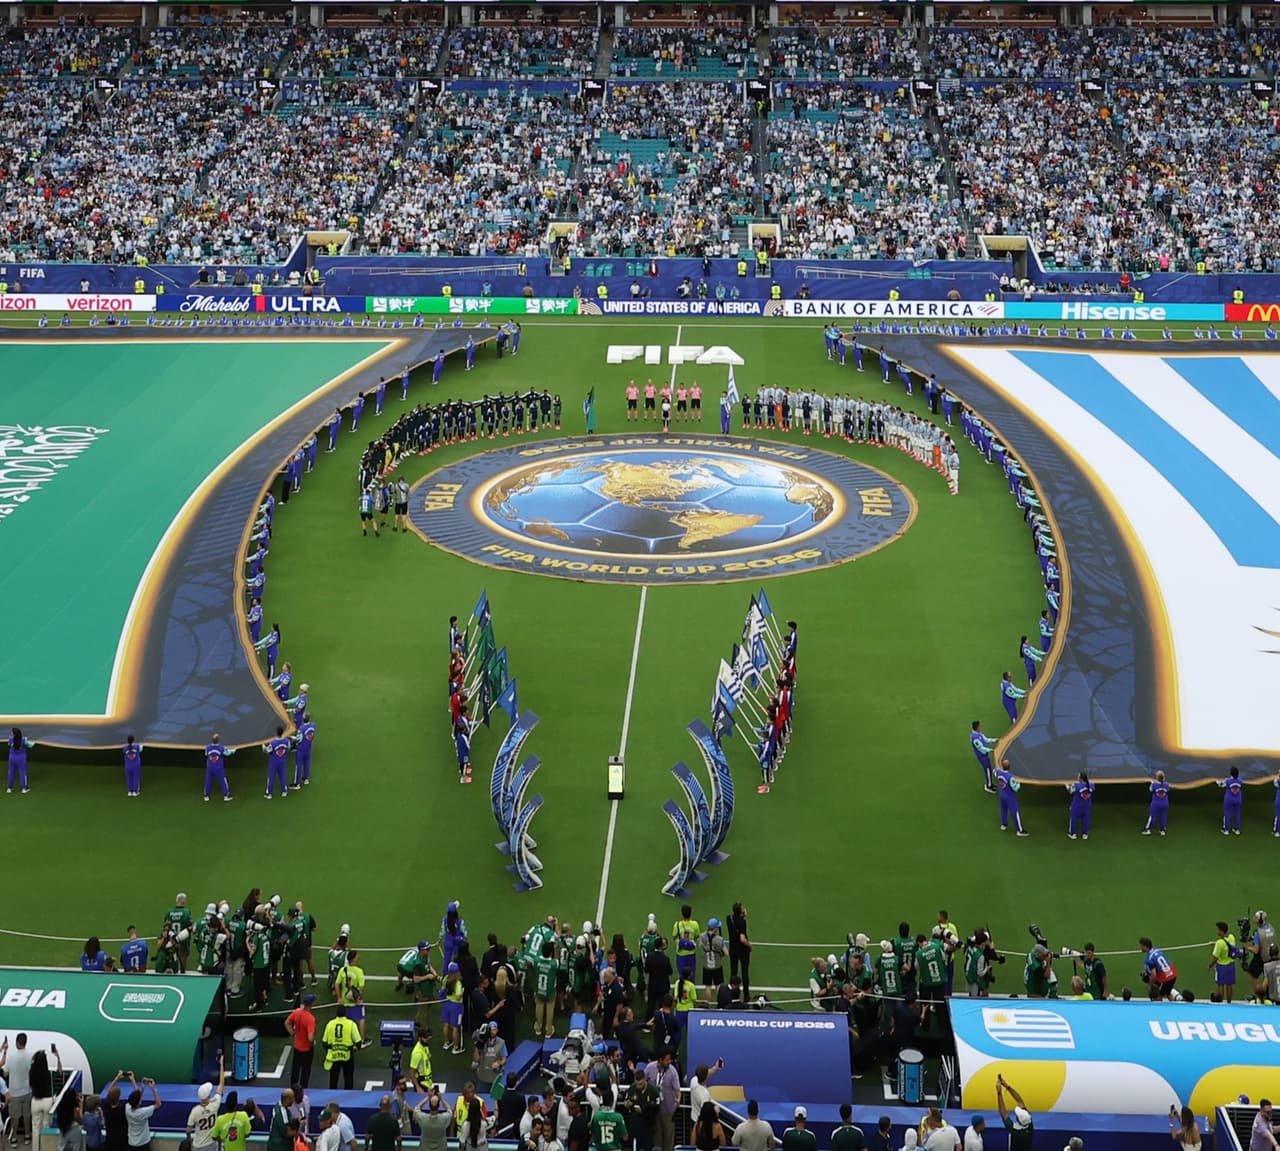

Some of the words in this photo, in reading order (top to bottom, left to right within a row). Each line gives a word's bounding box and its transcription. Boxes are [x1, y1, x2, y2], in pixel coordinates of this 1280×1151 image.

[20, 268, 45, 279] FIFA
[67, 295, 132, 310] verizon
[179, 294, 250, 312] Michelob
[271, 296, 341, 312] ULTRA
[603, 300, 646, 314] UNITED
[648, 300, 687, 314] STATES
[688, 301, 705, 314] OF
[793, 302, 846, 316] BANK
[852, 302, 876, 317] OF
[883, 302, 974, 317] AMERICA
[1061, 302, 1166, 321] Hisense
[606, 344, 745, 366] FIFA
[609, 438, 659, 446] CUP
[663, 438, 752, 450] WORLD
[425, 483, 460, 512] FIFA
[859, 487, 892, 516] FIFA
[480, 544, 536, 564] FIFA
[541, 557, 650, 574] WORLD
[656, 564, 717, 575] CUP
[722, 548, 822, 572] 2026
[700, 1019, 725, 1027] FIFA
[726, 1020, 768, 1028] WORLD
[794, 1022, 836, 1030] 2026
[198, 1114, 216, 1131] 20
[600, 1126, 614, 1144] 15
